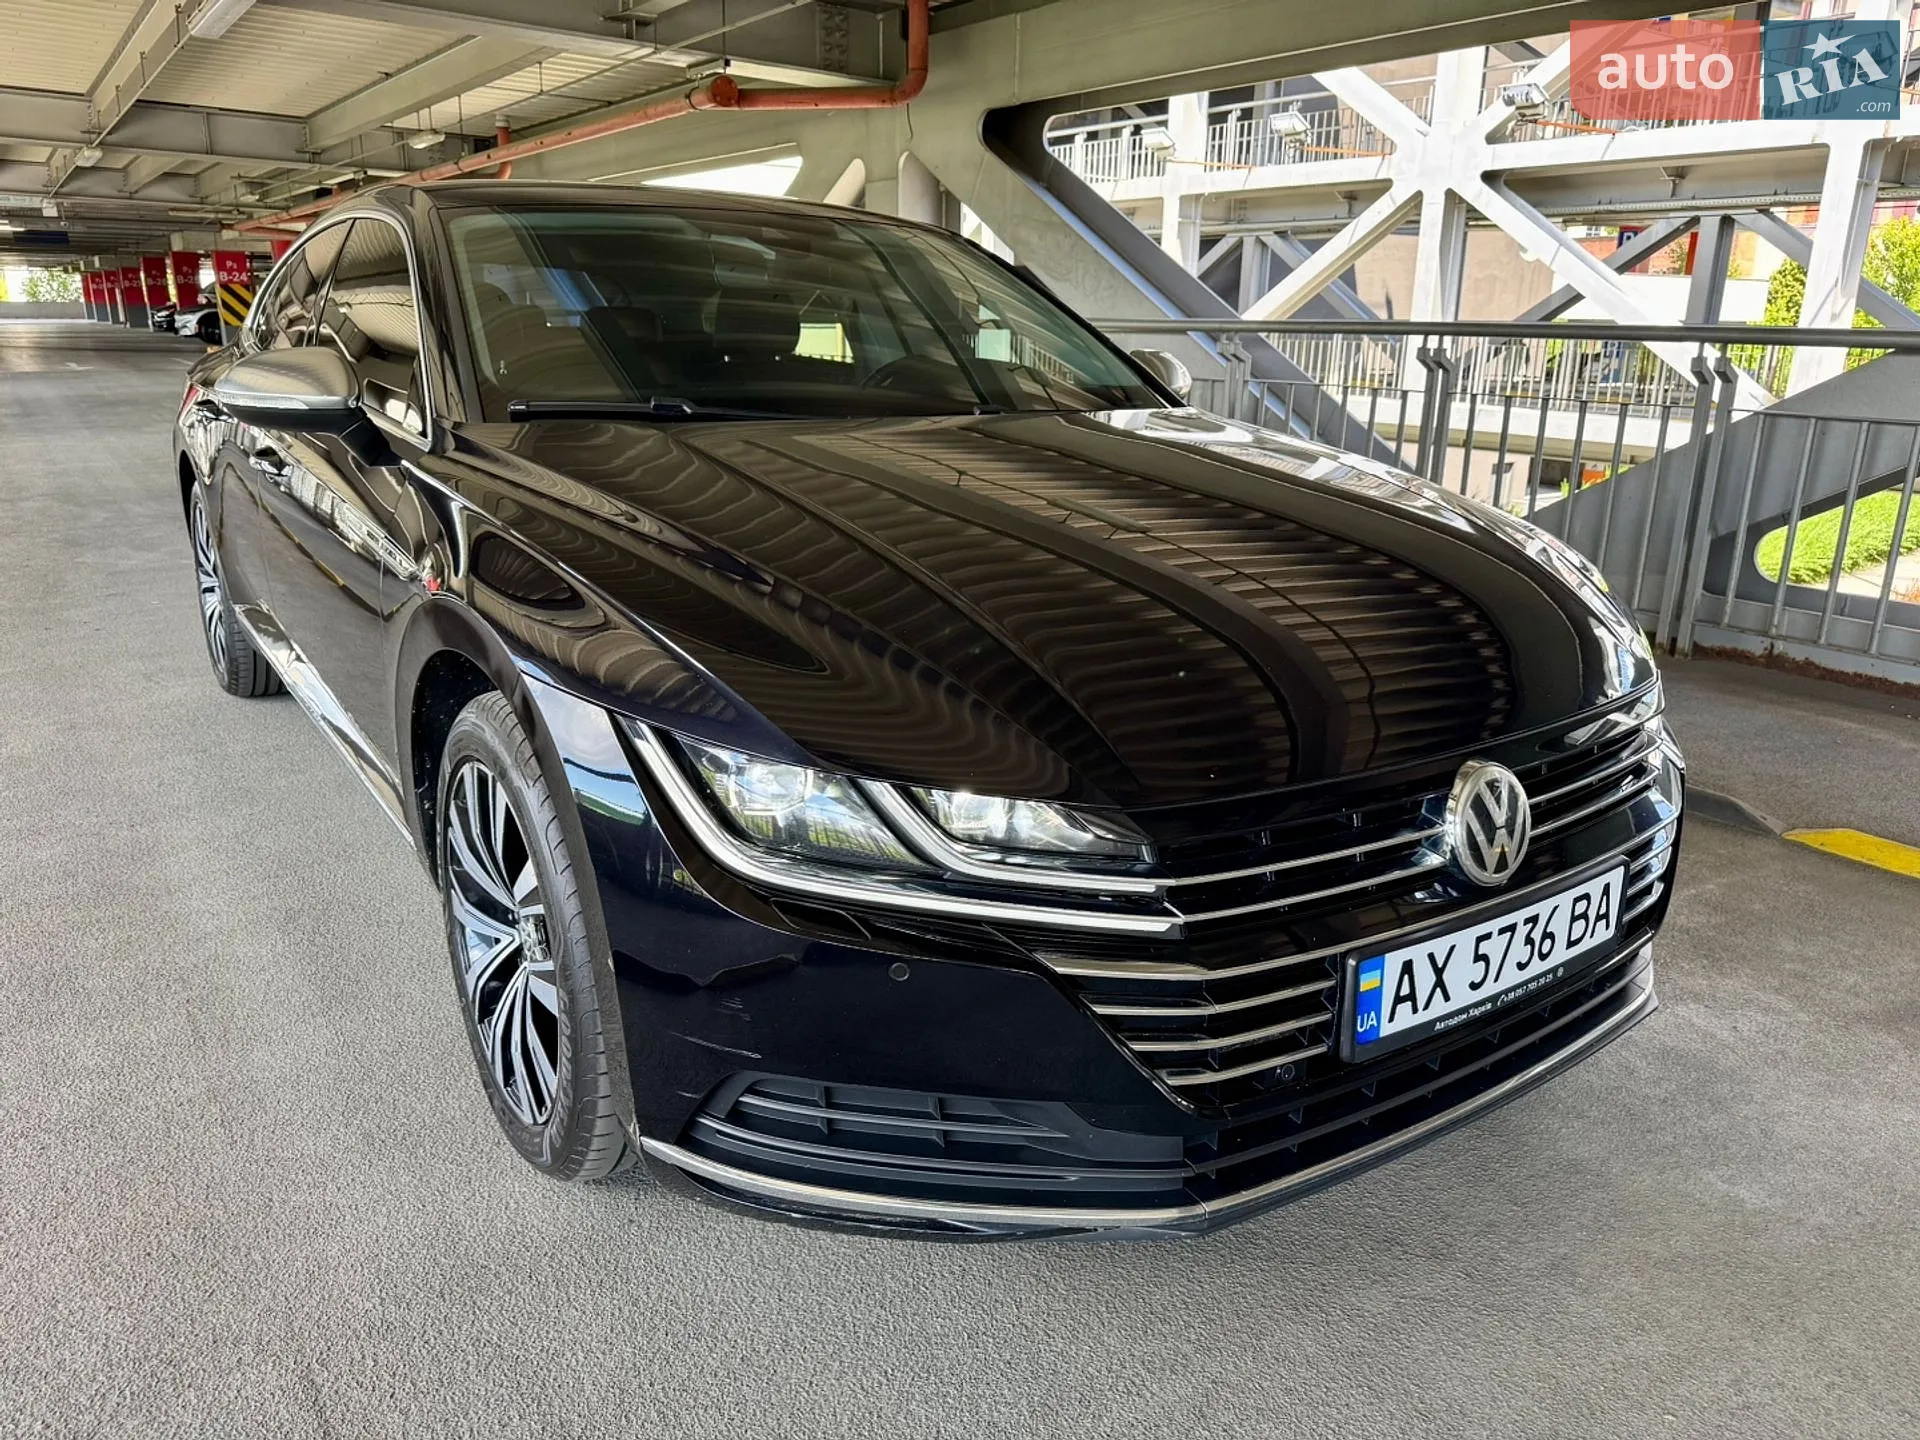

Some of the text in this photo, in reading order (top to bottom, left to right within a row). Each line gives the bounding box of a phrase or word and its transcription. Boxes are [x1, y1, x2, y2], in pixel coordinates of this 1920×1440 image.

[219, 271, 248, 281] B-24
[1388, 882, 1611, 1023] AX 5736 BA
[1357, 1010, 1378, 1033] UA
